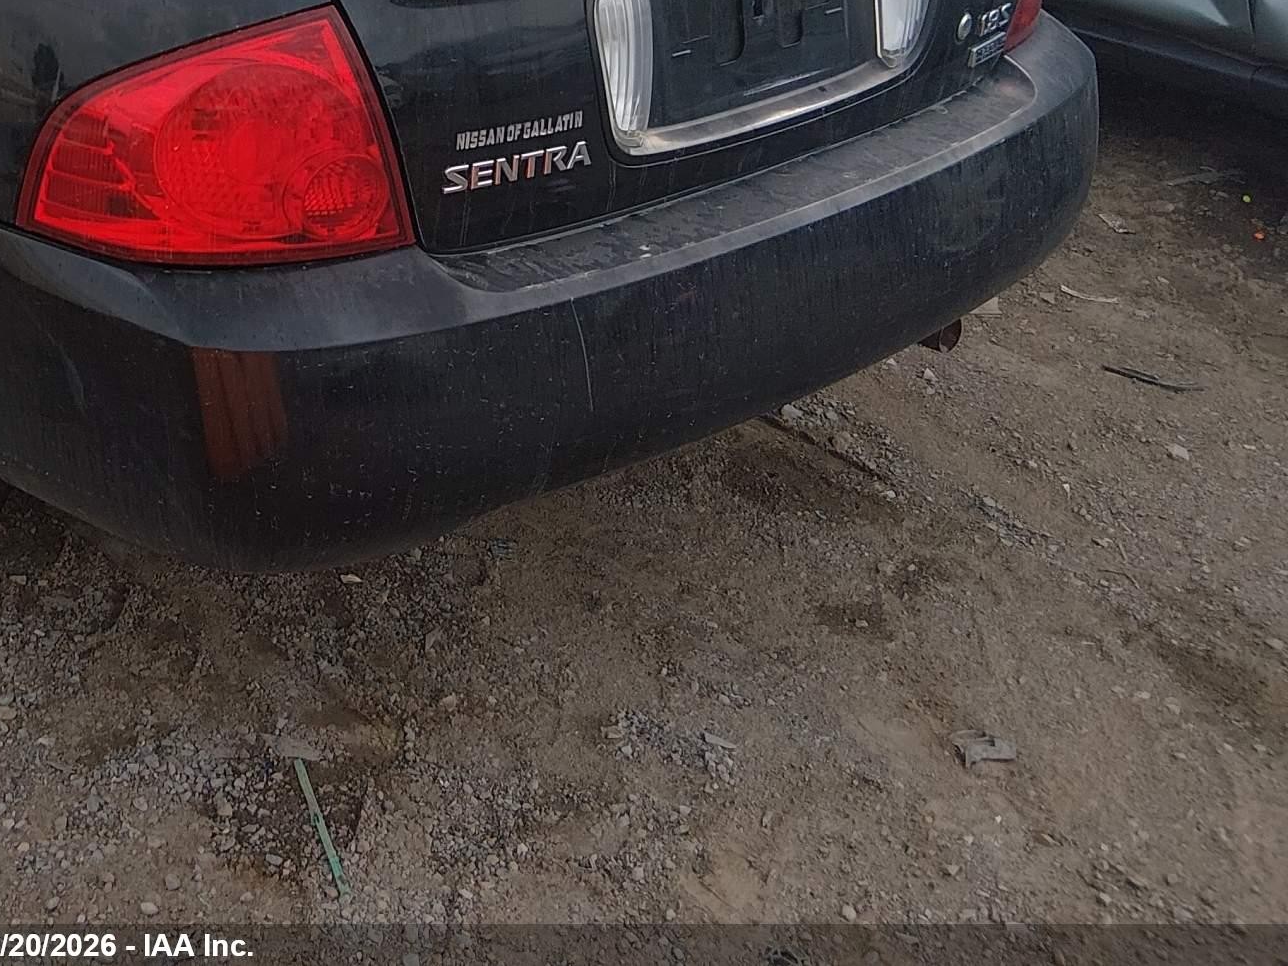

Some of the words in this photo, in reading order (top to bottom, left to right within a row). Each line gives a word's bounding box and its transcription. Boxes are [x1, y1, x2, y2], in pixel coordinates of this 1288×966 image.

[456, 124, 505, 151] NISSAN
[507, 121, 522, 142] OF
[523, 110, 583, 139] GALLATIN
[442, 141, 592, 194] SENTRA
